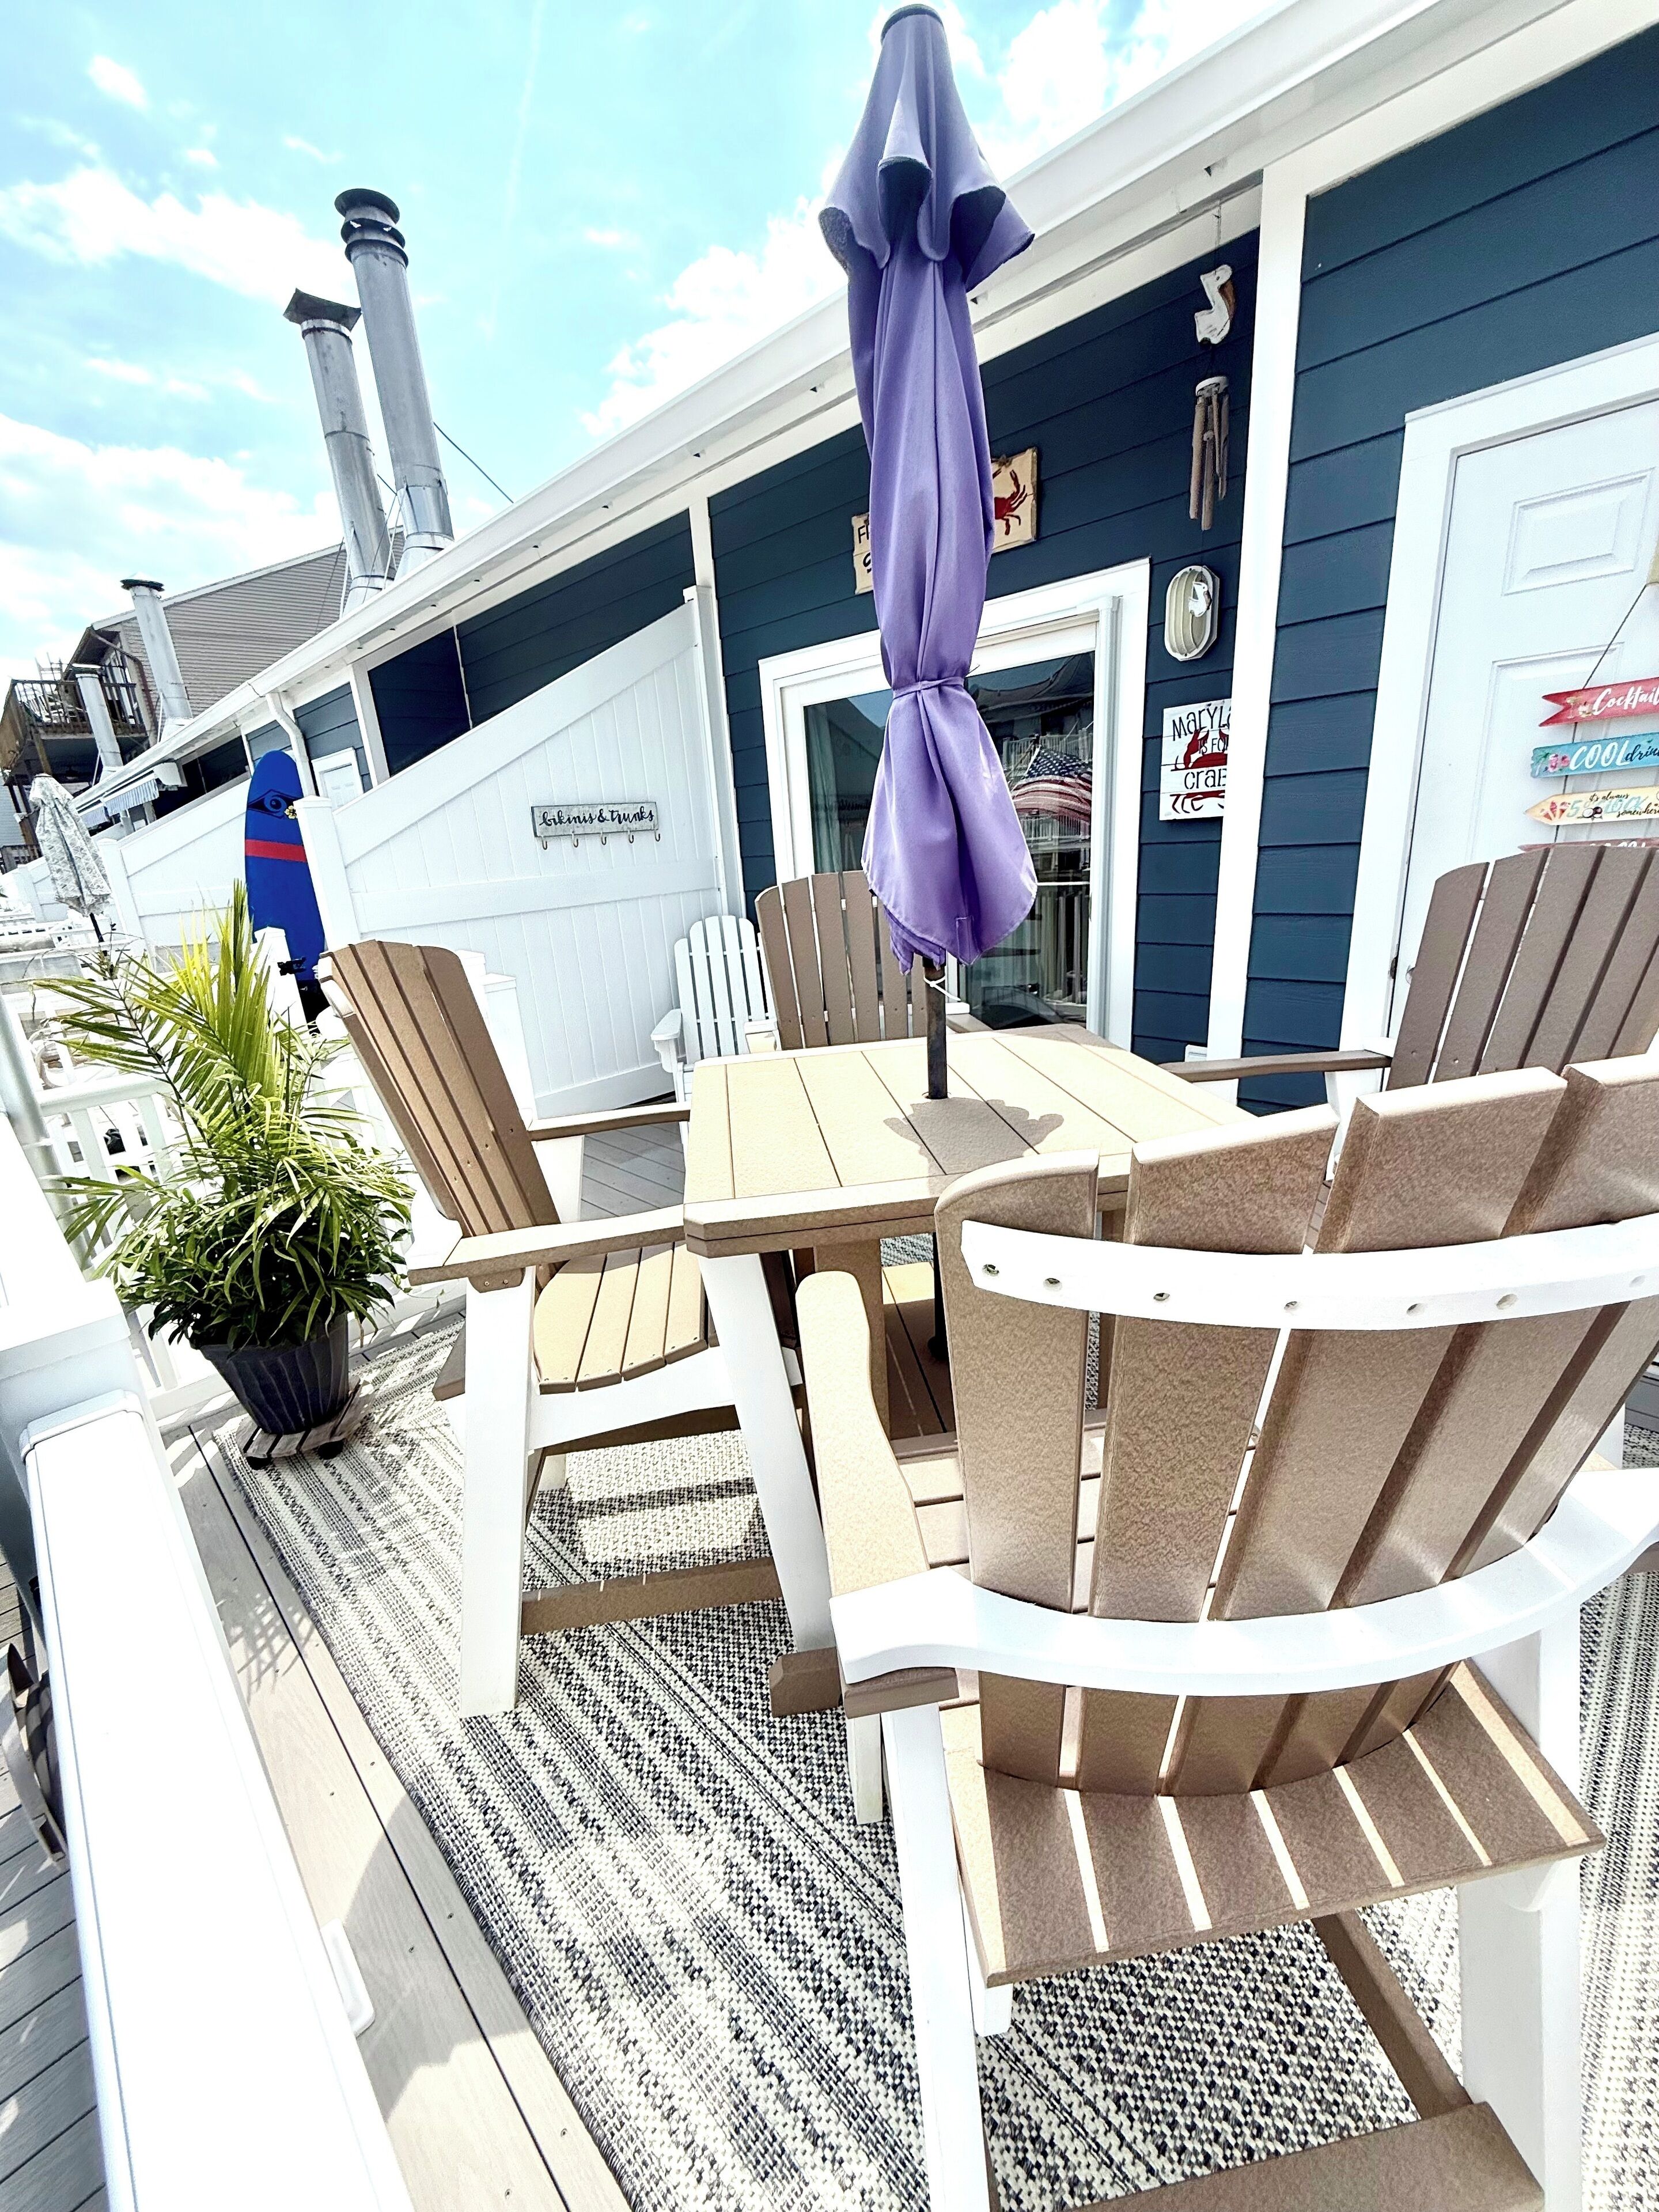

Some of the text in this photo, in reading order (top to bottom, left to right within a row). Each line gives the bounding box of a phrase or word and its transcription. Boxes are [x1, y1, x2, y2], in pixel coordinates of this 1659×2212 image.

[1569, 740, 1630, 771] COOL
[539, 806, 654, 827] bikinis & trunks
[1566, 800, 1583, 817] 5
